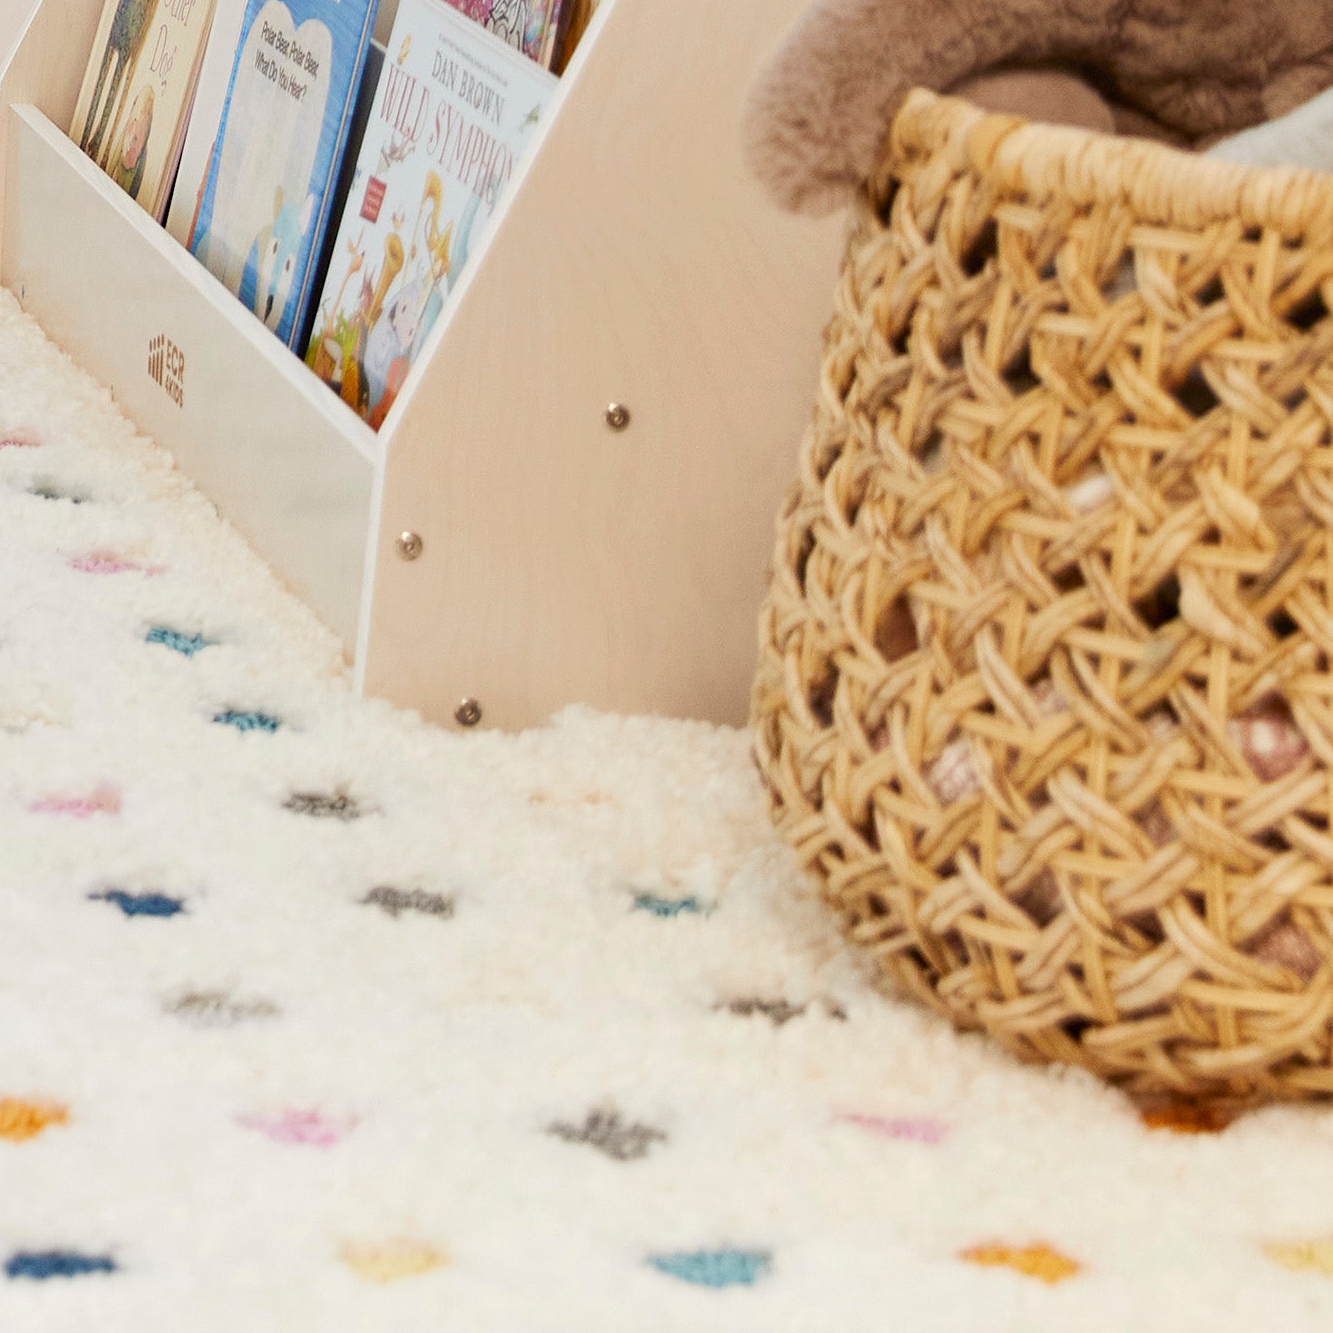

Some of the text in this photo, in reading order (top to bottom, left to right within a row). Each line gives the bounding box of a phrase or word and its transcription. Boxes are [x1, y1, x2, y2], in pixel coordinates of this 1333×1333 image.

[149, 22, 177, 97] Dog
[261, 20, 277, 47] Polar
[288, 41, 304, 68] Polar
[254, 50, 308, 104] What Do You Hear?
[380, 62, 429, 143] WILD
[431, 50, 458, 92] DAN
[458, 70, 506, 125] BROWN
[166, 338, 184, 384] ECR
